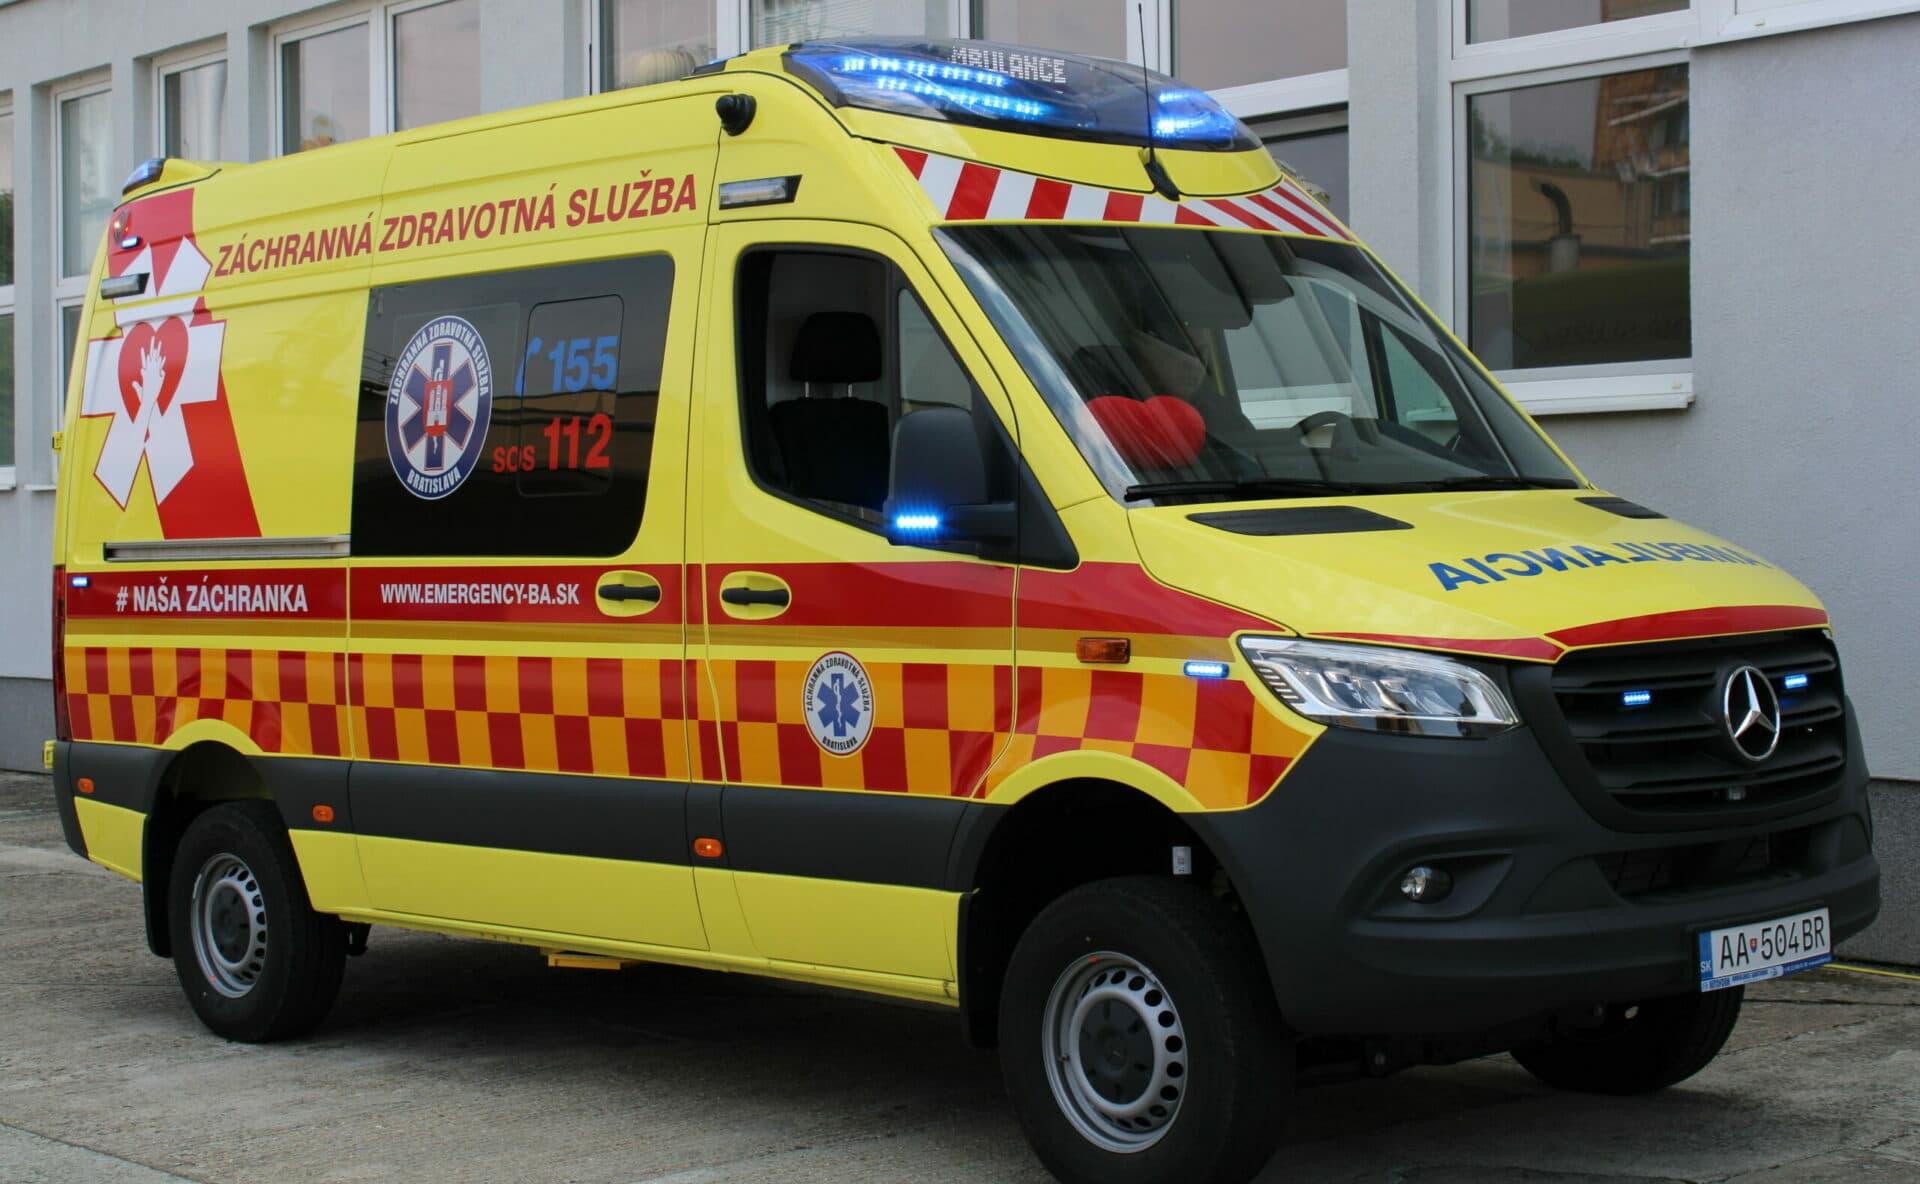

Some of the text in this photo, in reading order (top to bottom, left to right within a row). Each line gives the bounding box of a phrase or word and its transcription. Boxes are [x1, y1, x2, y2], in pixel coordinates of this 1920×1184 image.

[947, 46, 1067, 83] MBULANCE
[214, 169, 698, 278] ZÁCHRANNÁ ZDRAVOTNÁ SLUŽBA
[547, 335, 619, 393] 155
[492, 413, 613, 472] SOS 112
[407, 466, 462, 493] BRATISLAVA
[116, 576, 308, 613] # NAŠA ZÁCHRANKA
[381, 583, 580, 605] WWW.EMERGENCY-BA.SK
[822, 736, 858, 751] BRATISLAVA
[1700, 960, 1712, 973] SK
[1720, 932, 1749, 969] AA
